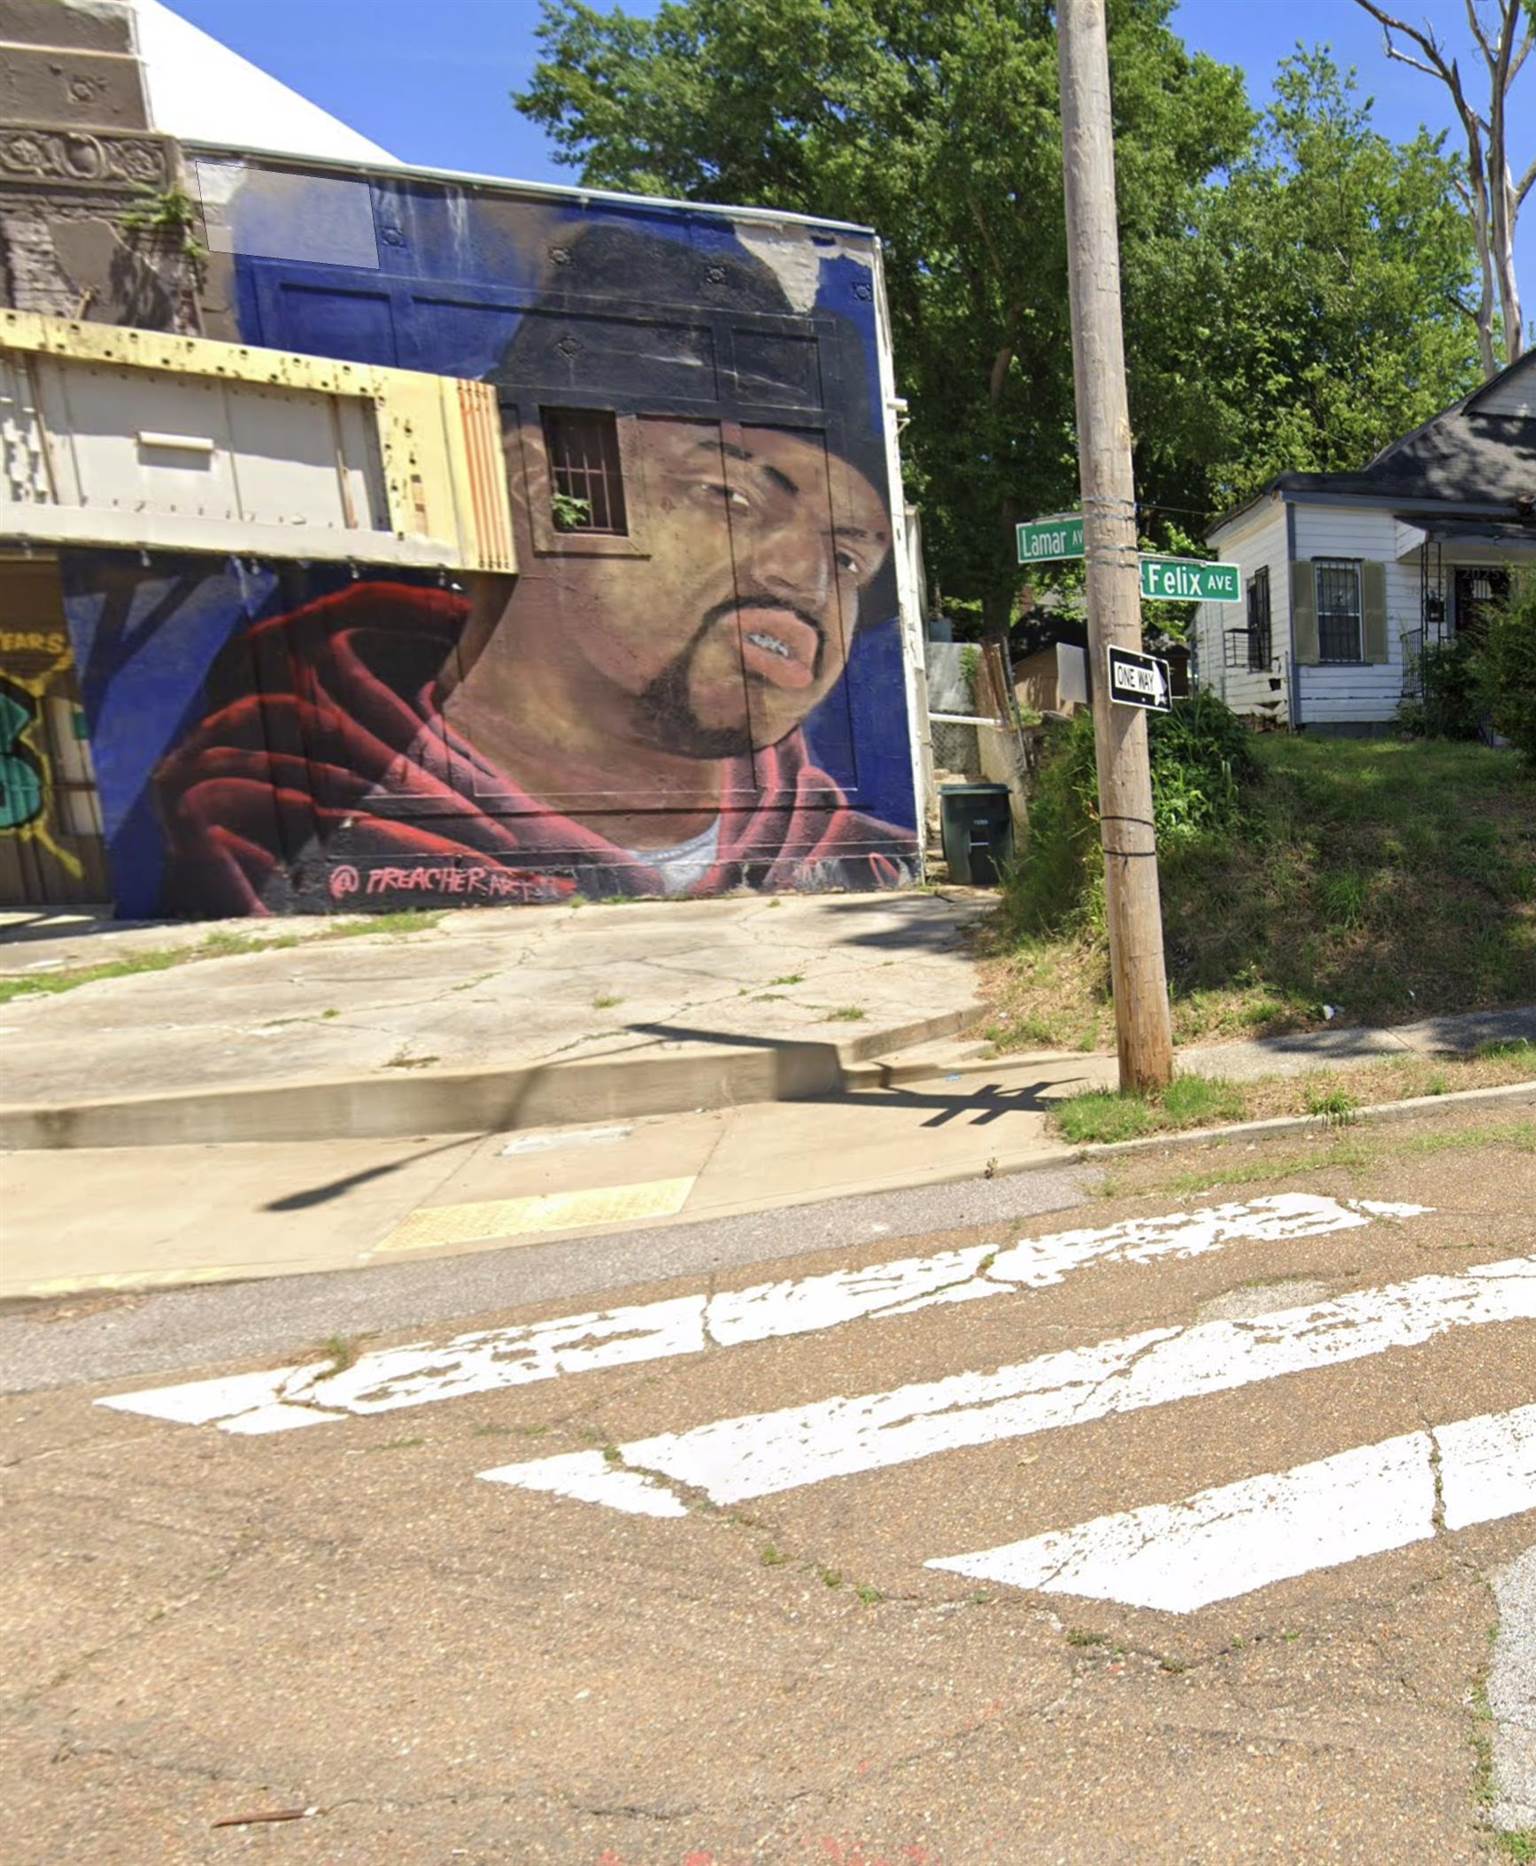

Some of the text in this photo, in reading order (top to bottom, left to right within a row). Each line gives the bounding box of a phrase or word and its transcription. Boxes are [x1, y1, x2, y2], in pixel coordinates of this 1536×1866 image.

[1021, 529, 1084, 557] Lamar AV
[1148, 563, 1233, 596] Felix AVE
[1117, 665, 1154, 692] ONE WAY
